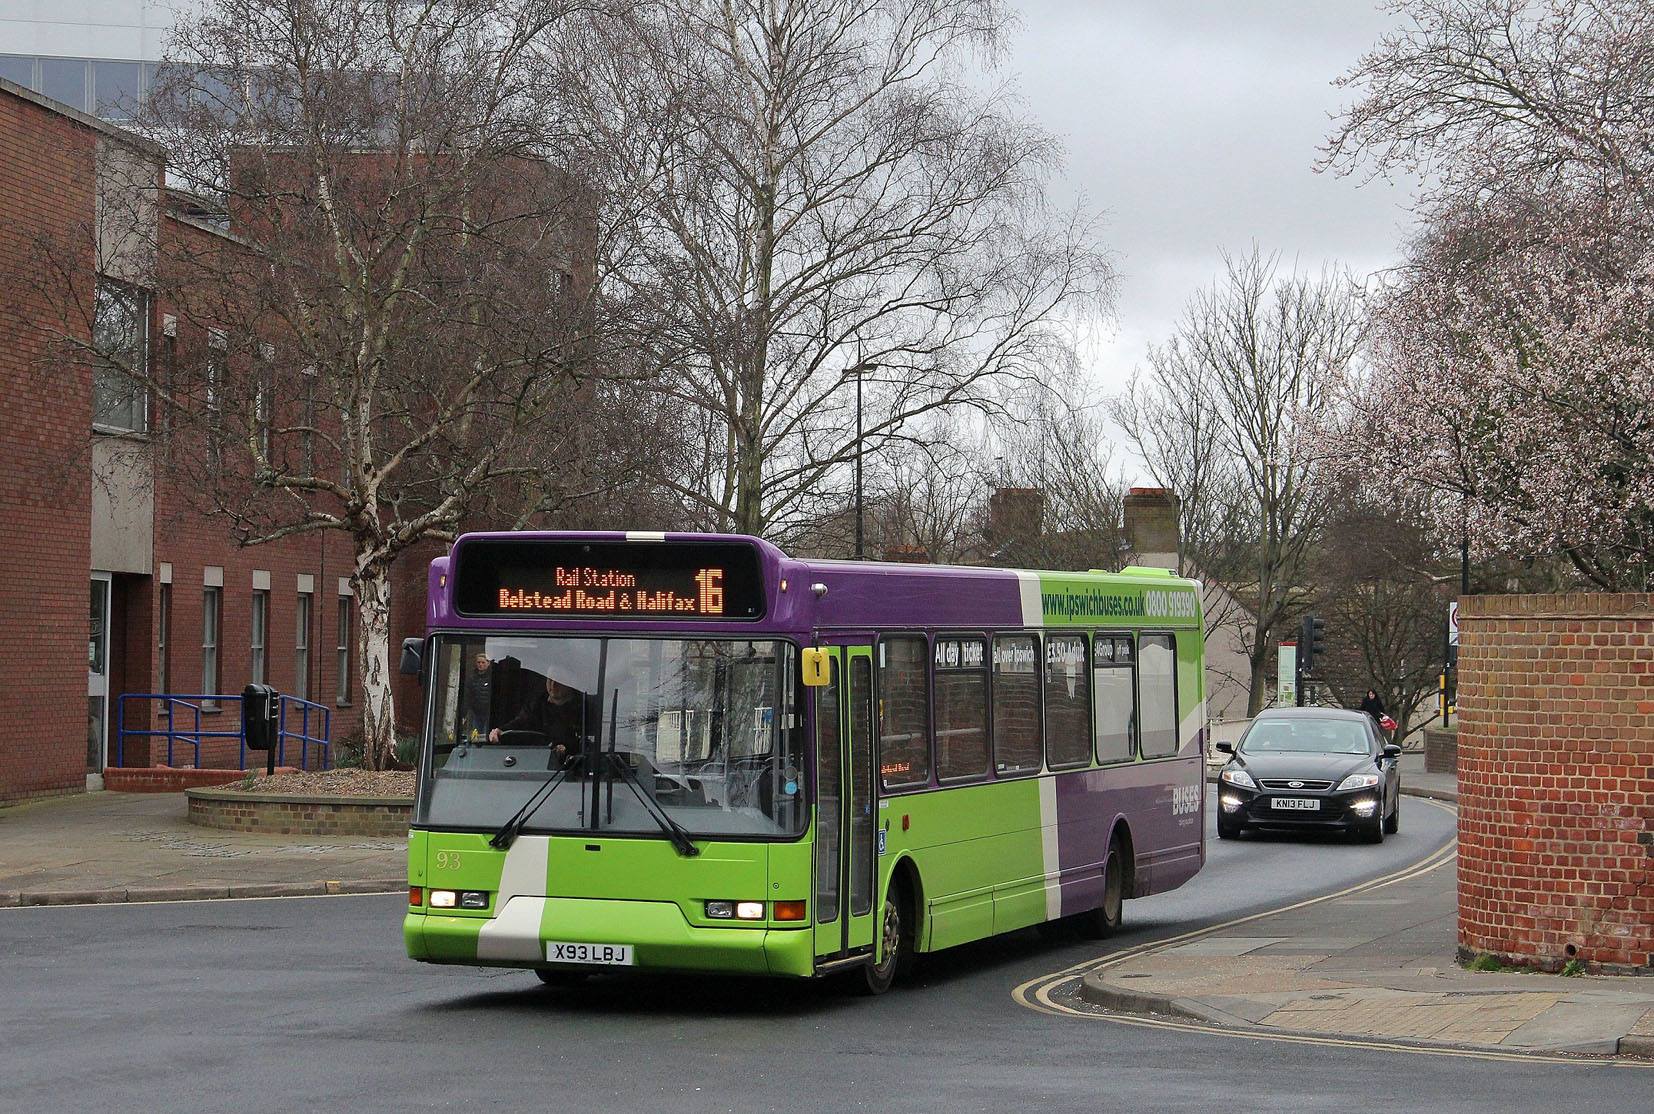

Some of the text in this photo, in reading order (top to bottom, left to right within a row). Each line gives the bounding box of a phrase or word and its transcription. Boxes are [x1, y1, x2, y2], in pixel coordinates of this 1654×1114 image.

[556, 567, 635, 587] Rail Station
[499, 588, 695, 611] Belstead Road & Halifax
[695, 569, 722, 613] 16
[1042, 587, 1144, 621] www.ipswichbuses.co.uk
[1145, 590, 1196, 617] 0800 919390
[935, 641, 983, 667] All day ticket
[1047, 642, 1066, 663] £3.50
[1172, 784, 1199, 816] BUSES
[1276, 799, 1315, 809] KN13 FLJ
[436, 851, 461, 871] 93
[555, 944, 625, 962] X93 LBJ
